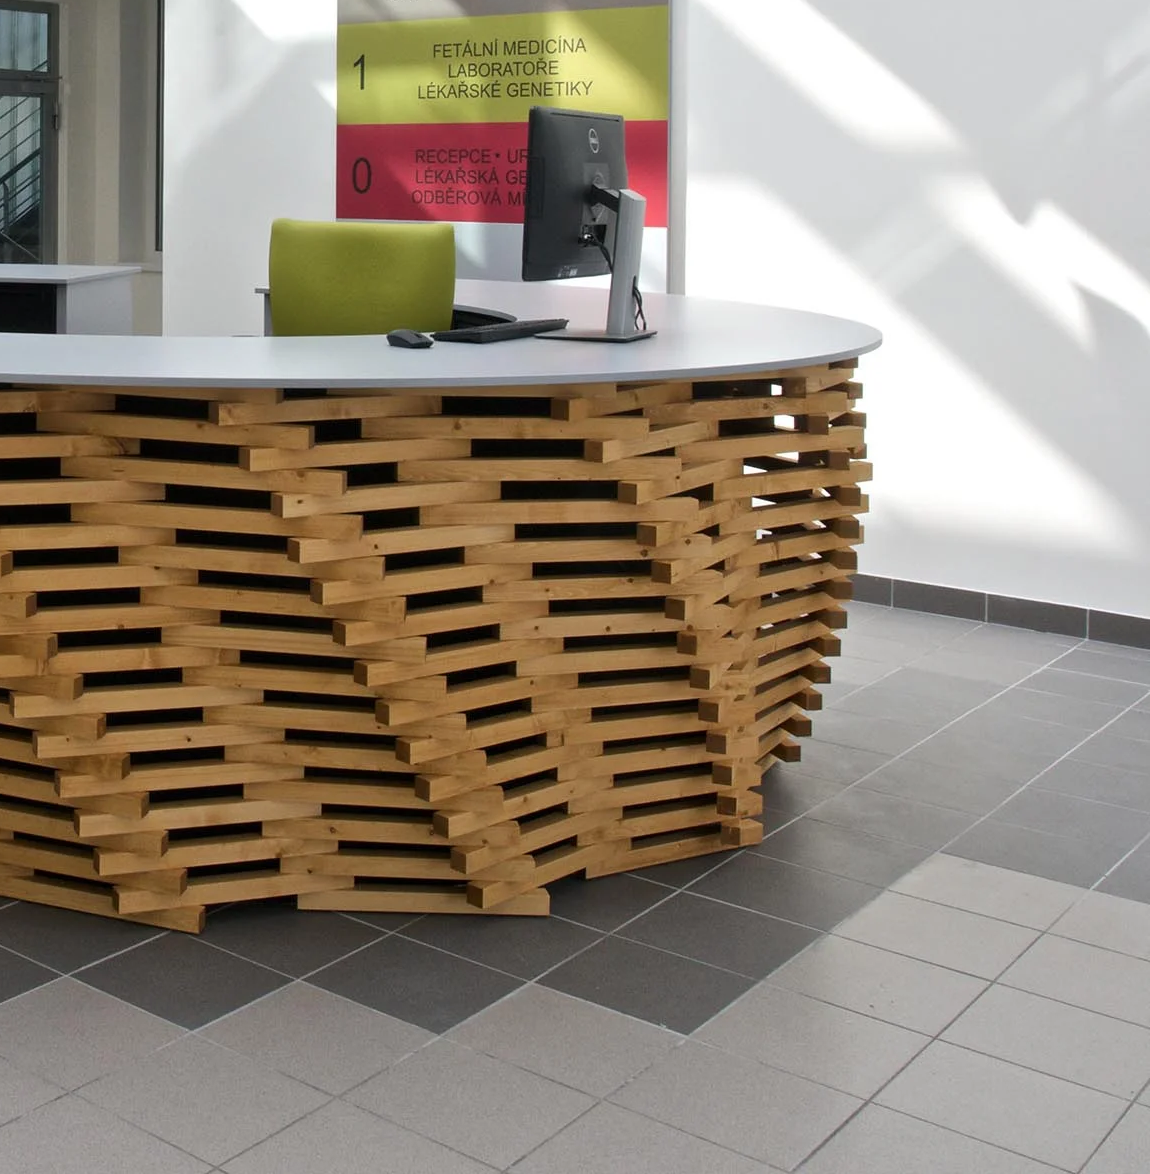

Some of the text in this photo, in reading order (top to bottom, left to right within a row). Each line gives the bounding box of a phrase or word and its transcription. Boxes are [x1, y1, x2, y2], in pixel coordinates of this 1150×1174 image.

[433, 37, 587, 59] FETÁLNÍ MEDICÍNA
[352, 54, 366, 90] 1
[447, 58, 559, 79] LABORATOŘE
[417, 80, 593, 99] LÉKAŘSKÉ GENETIKY
[414, 148, 491, 164] RECEPCE
[352, 157, 373, 194] 0
[415, 167, 499, 184] LÉKAŘSKÁ
[411, 187, 501, 205] ODBĚROVÁ
